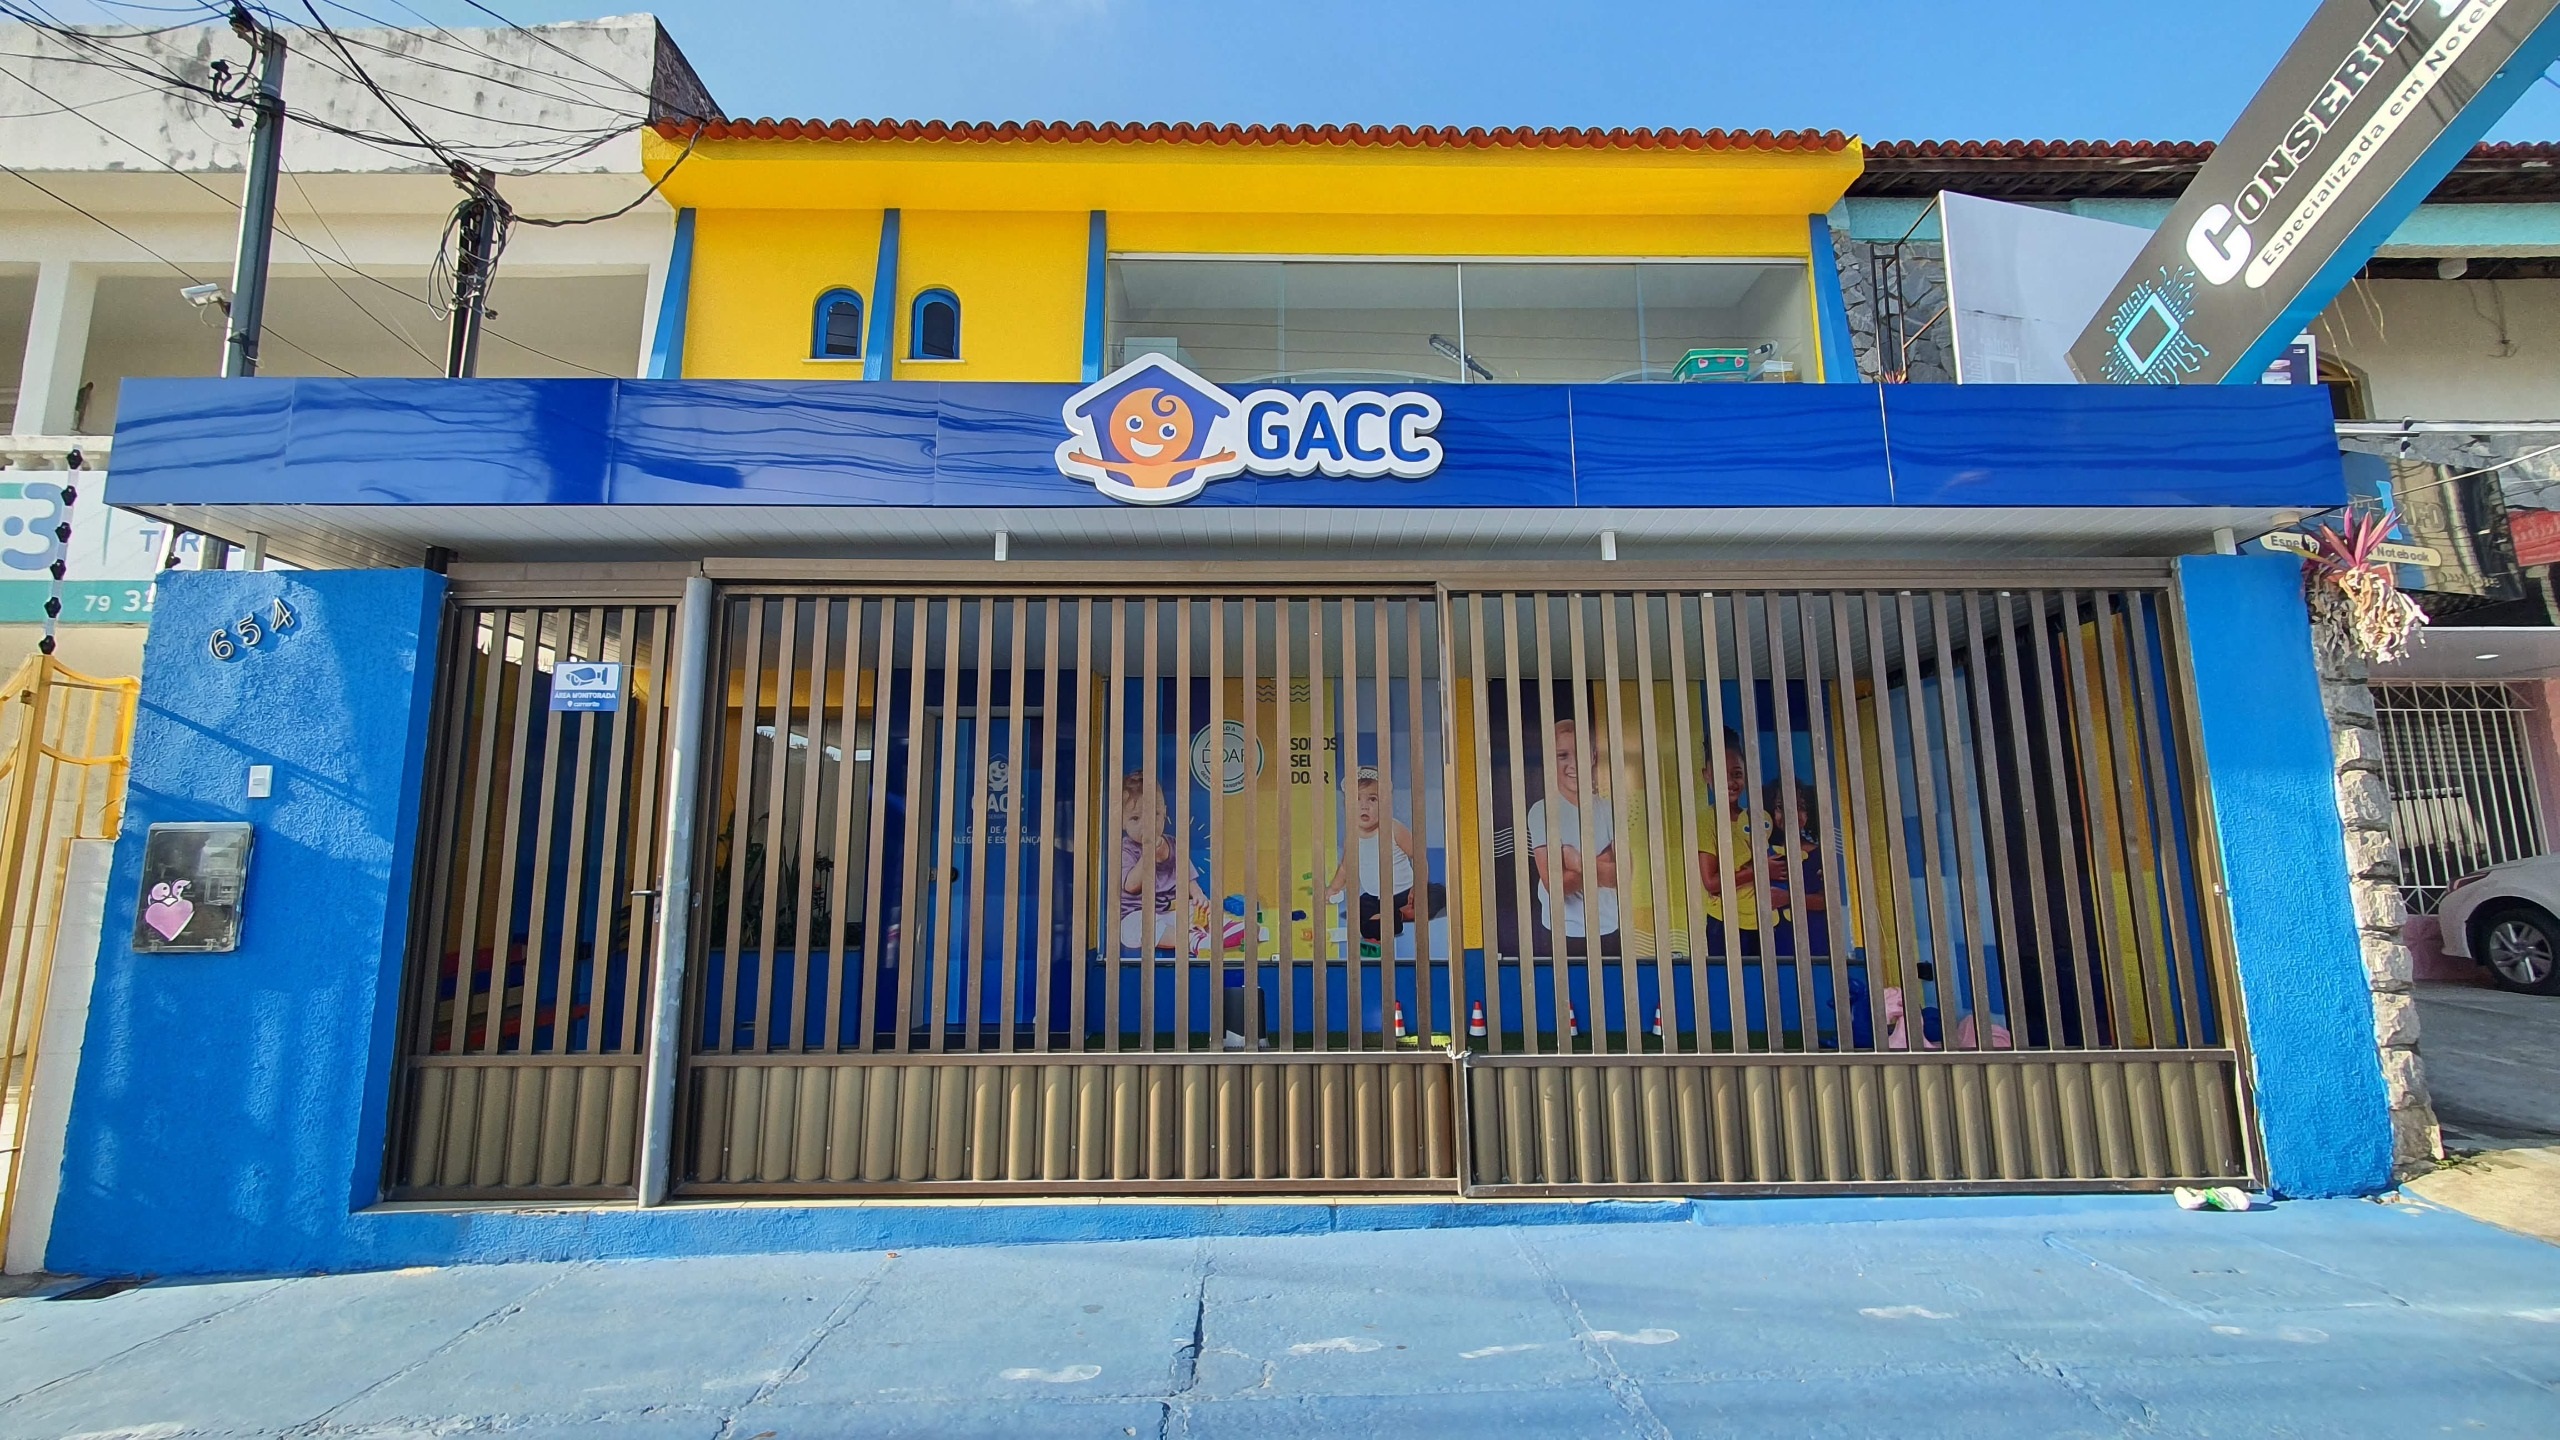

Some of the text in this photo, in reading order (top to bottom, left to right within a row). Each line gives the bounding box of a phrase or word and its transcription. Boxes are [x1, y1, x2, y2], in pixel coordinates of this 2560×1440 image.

[2261, 122, 2386, 268] Especializada
[2390, 79, 2425, 117] em
[1247, 400, 1430, 463] GACC
[84, 595, 111, 612] 79
[208, 597, 295, 660] 654
[1290, 737, 1338, 750] SOOS
